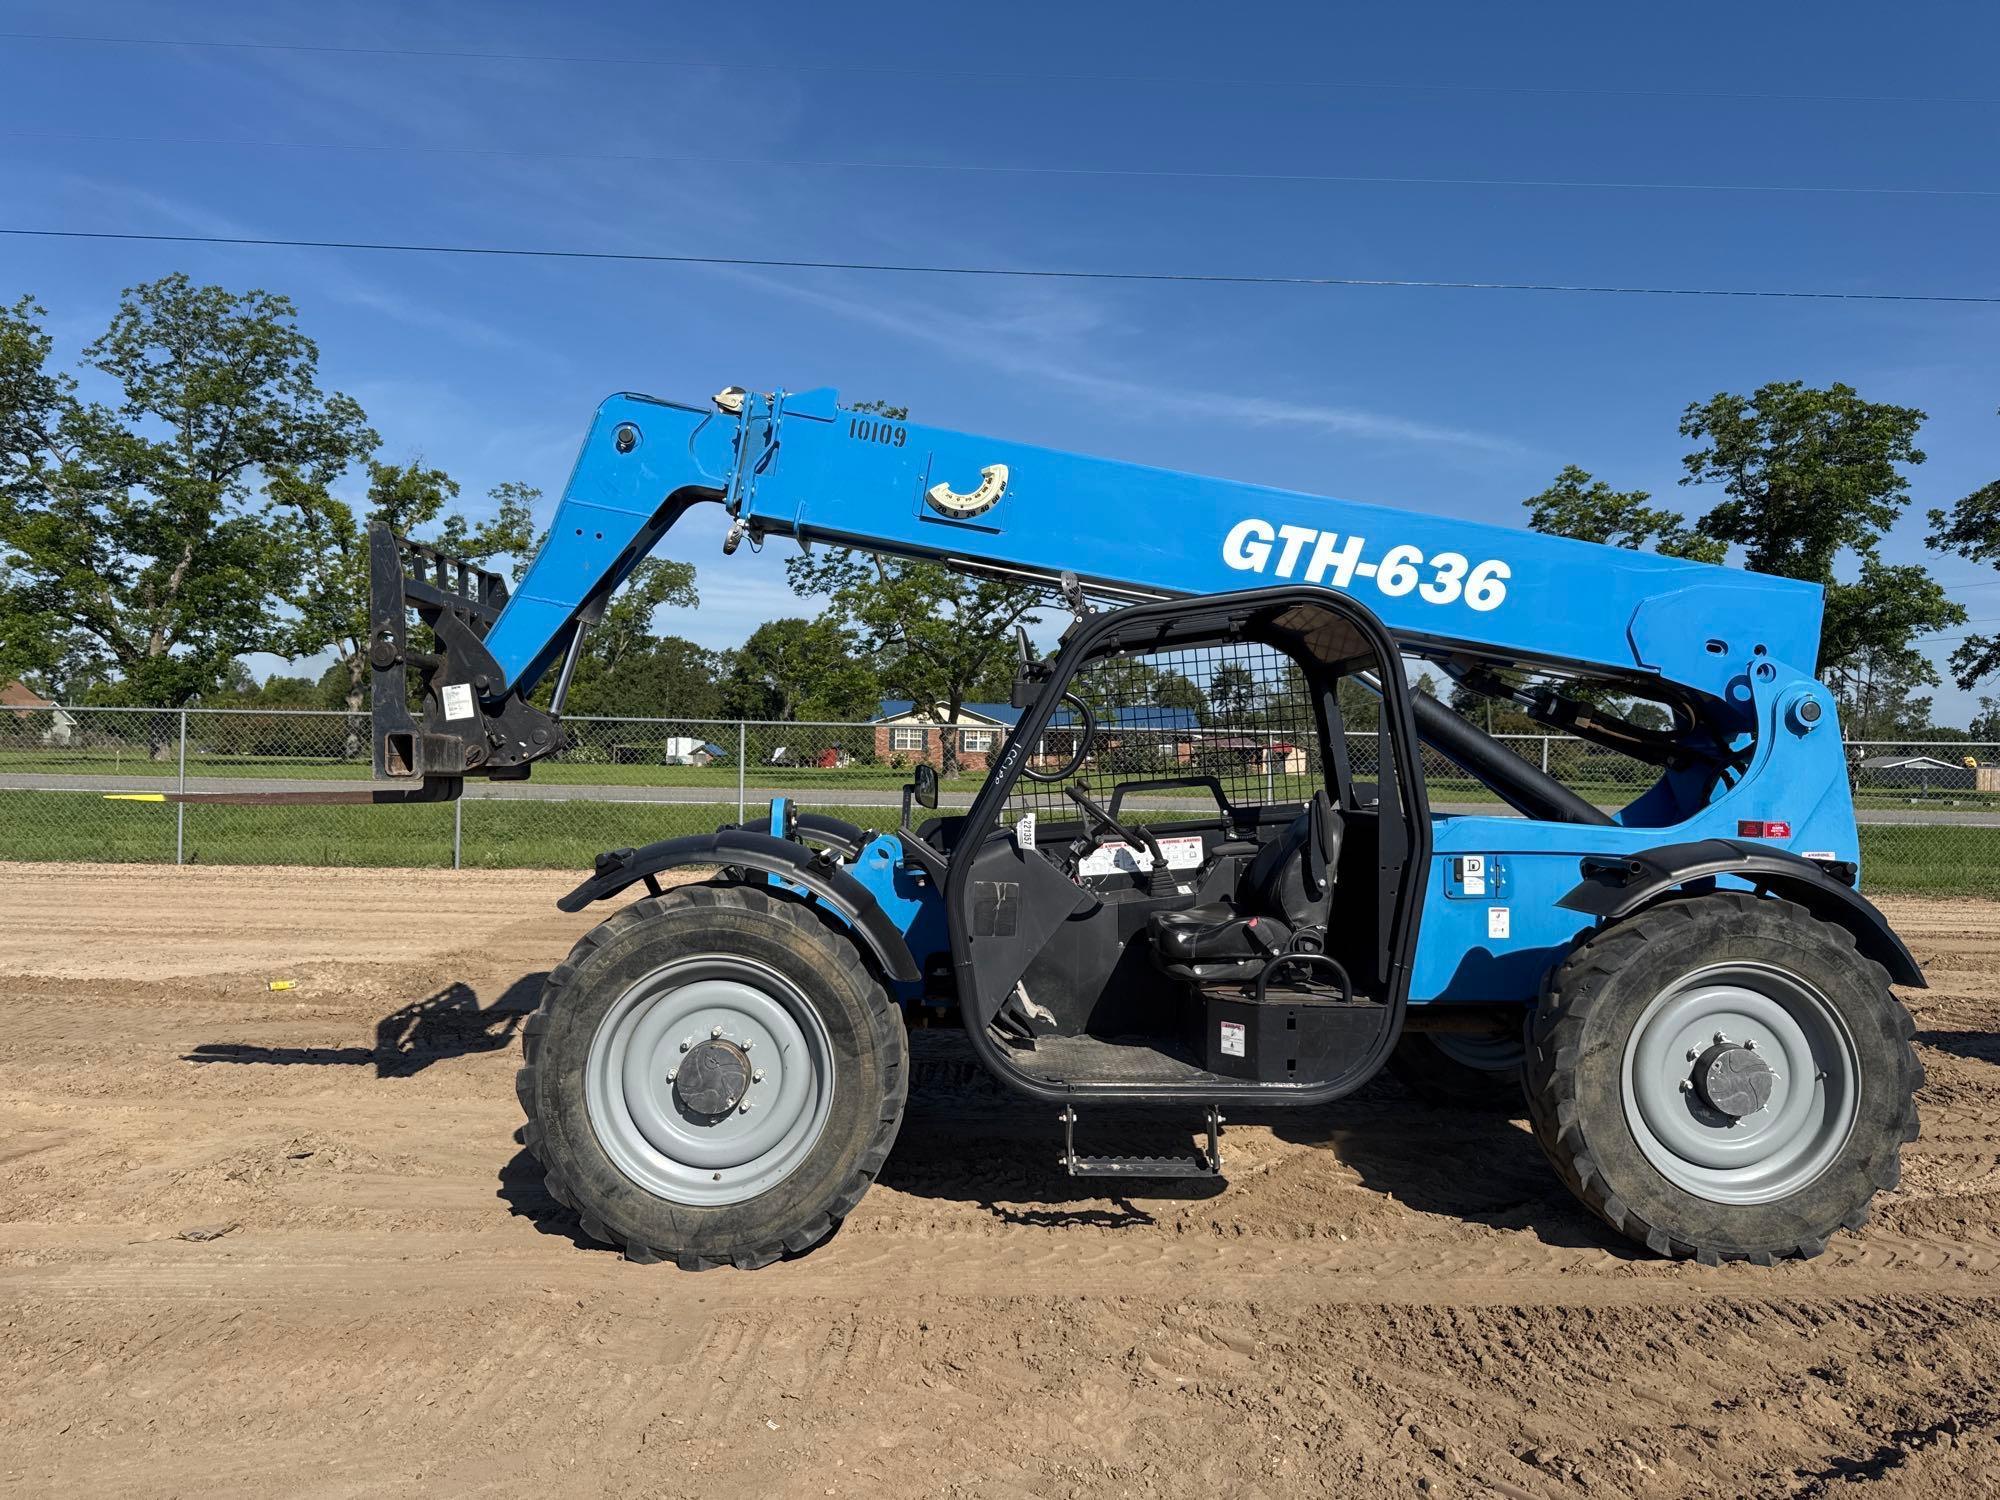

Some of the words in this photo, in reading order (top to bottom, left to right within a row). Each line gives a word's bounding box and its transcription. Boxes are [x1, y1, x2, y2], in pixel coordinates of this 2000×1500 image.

[849, 418, 907, 448] 10109
[1222, 518, 1512, 612] GTH-636
[1023, 820, 1032, 846] 221357
